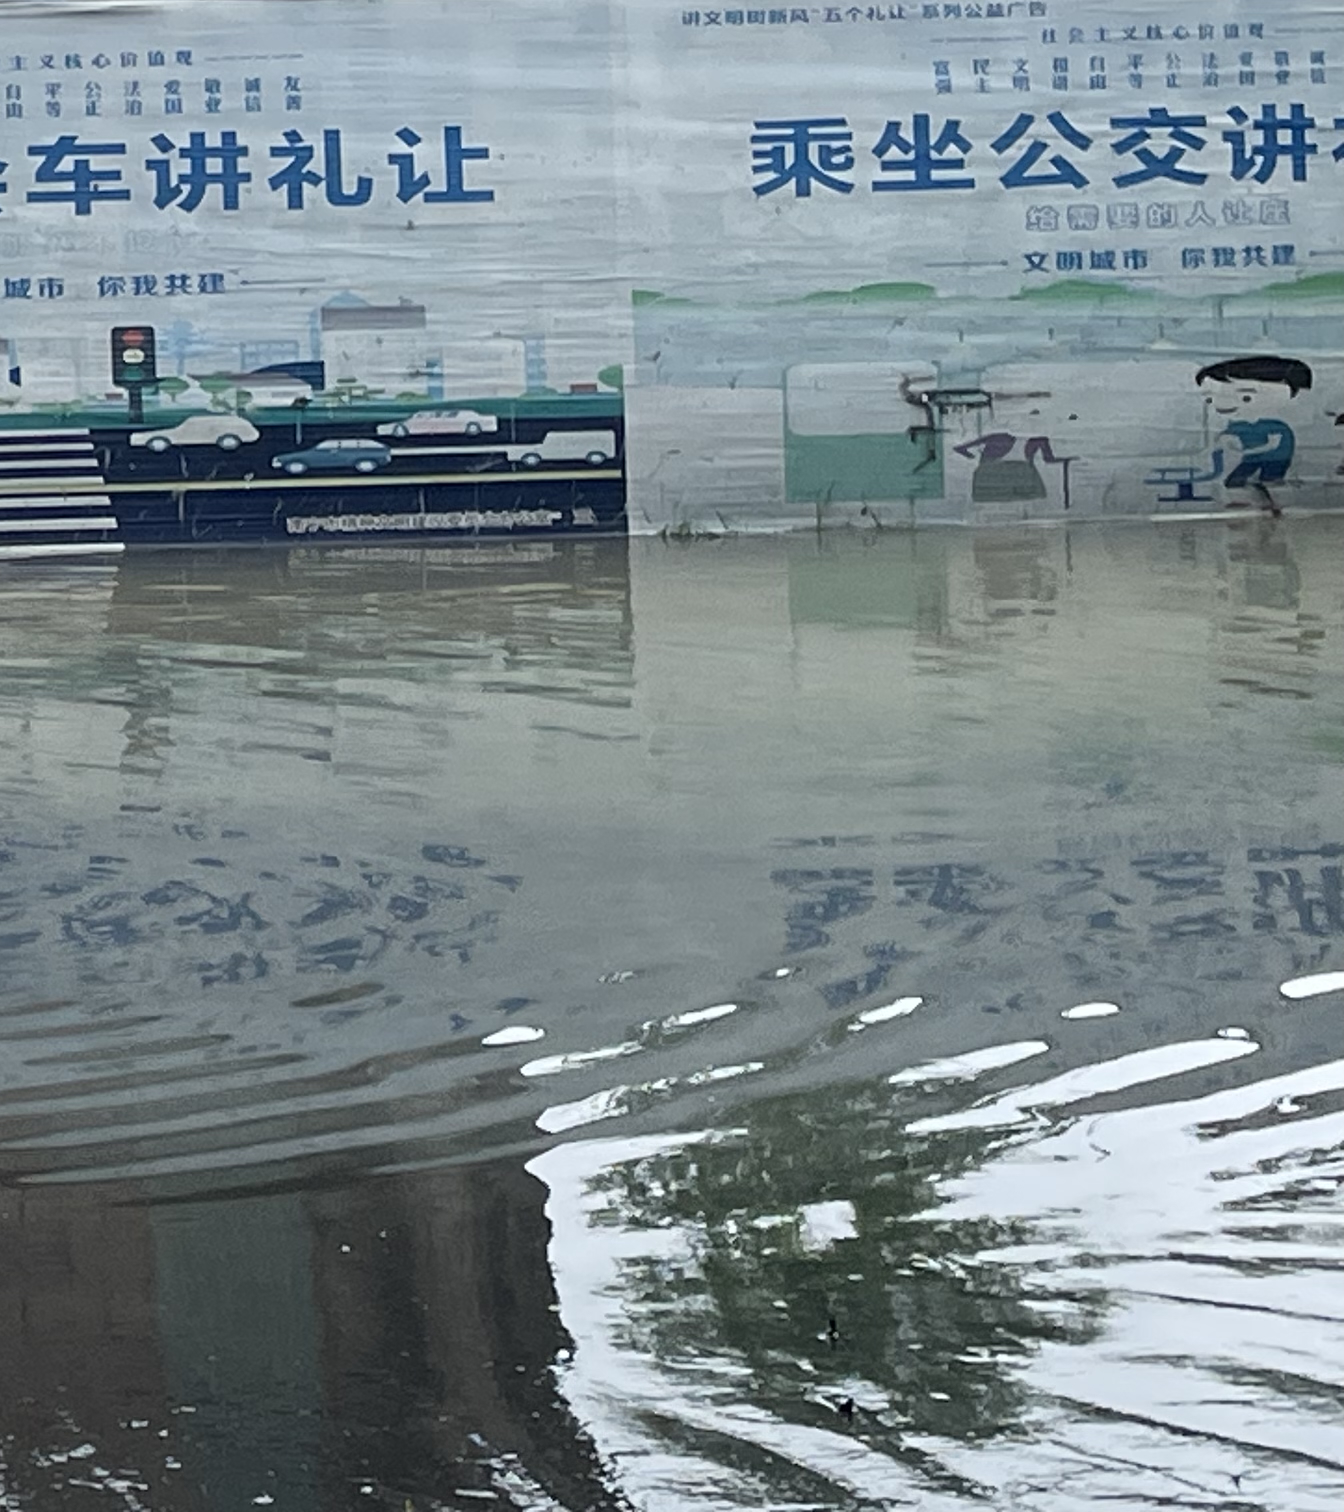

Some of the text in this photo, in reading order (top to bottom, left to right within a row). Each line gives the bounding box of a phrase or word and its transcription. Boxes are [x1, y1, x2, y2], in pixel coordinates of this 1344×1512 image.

[1023, 244, 1296, 273] 文明城市 你我共建
[97, 272, 226, 296] 你我共建
